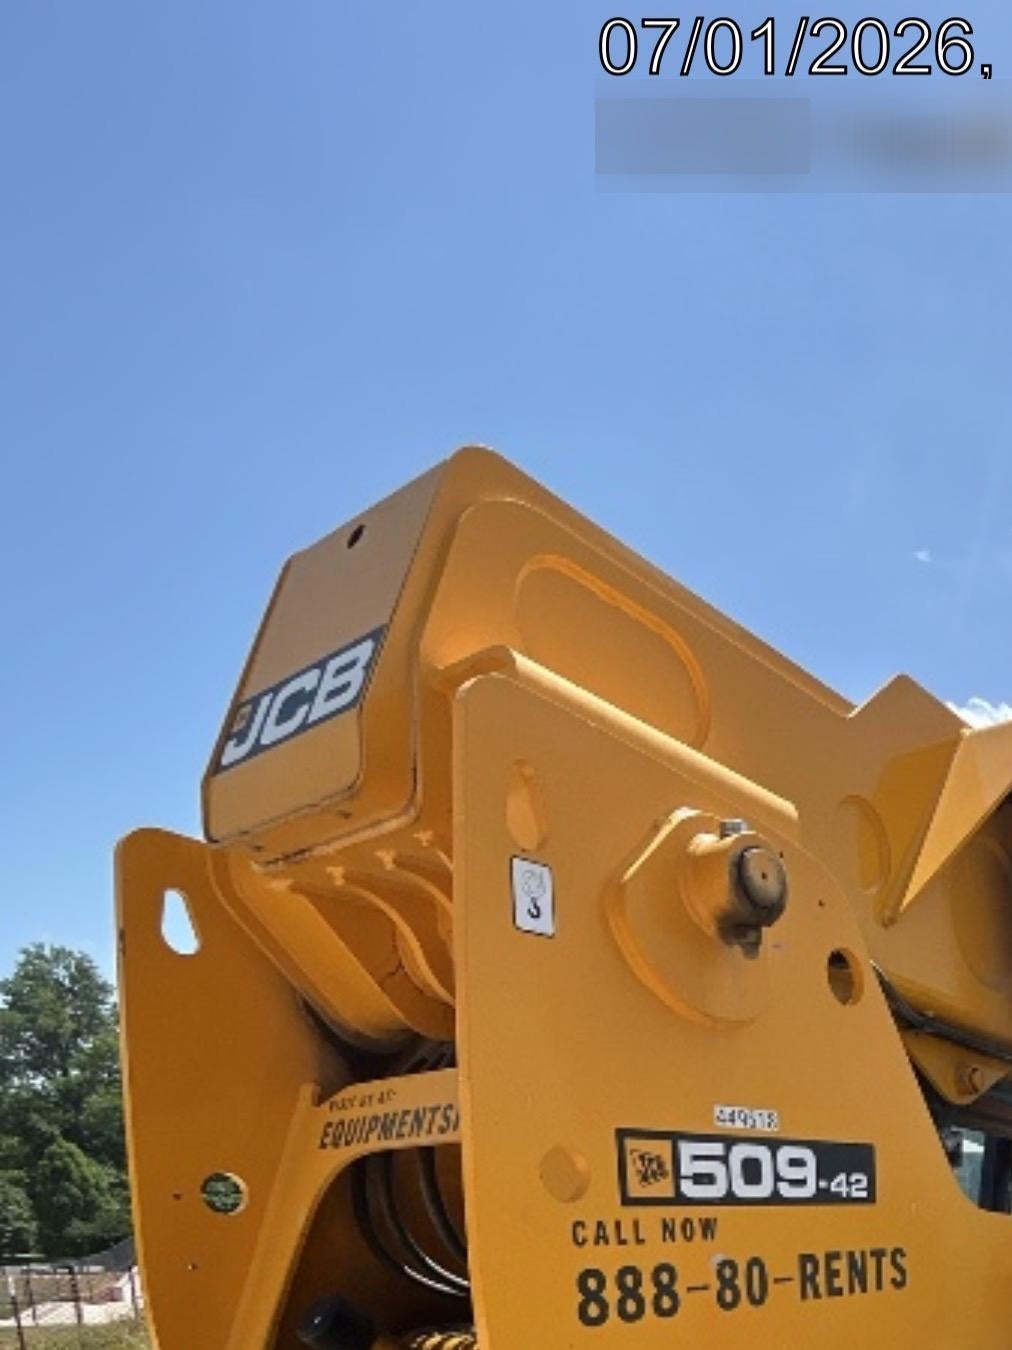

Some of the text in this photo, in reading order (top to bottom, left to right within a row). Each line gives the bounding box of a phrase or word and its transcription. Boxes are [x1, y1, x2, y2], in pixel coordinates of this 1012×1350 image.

[220, 637, 376, 768] JCB
[677, 1141, 869, 1199] 509-42
[571, 1217, 719, 1247] CALL NOW
[576, 1247, 907, 1327] 888-80-RENTS
